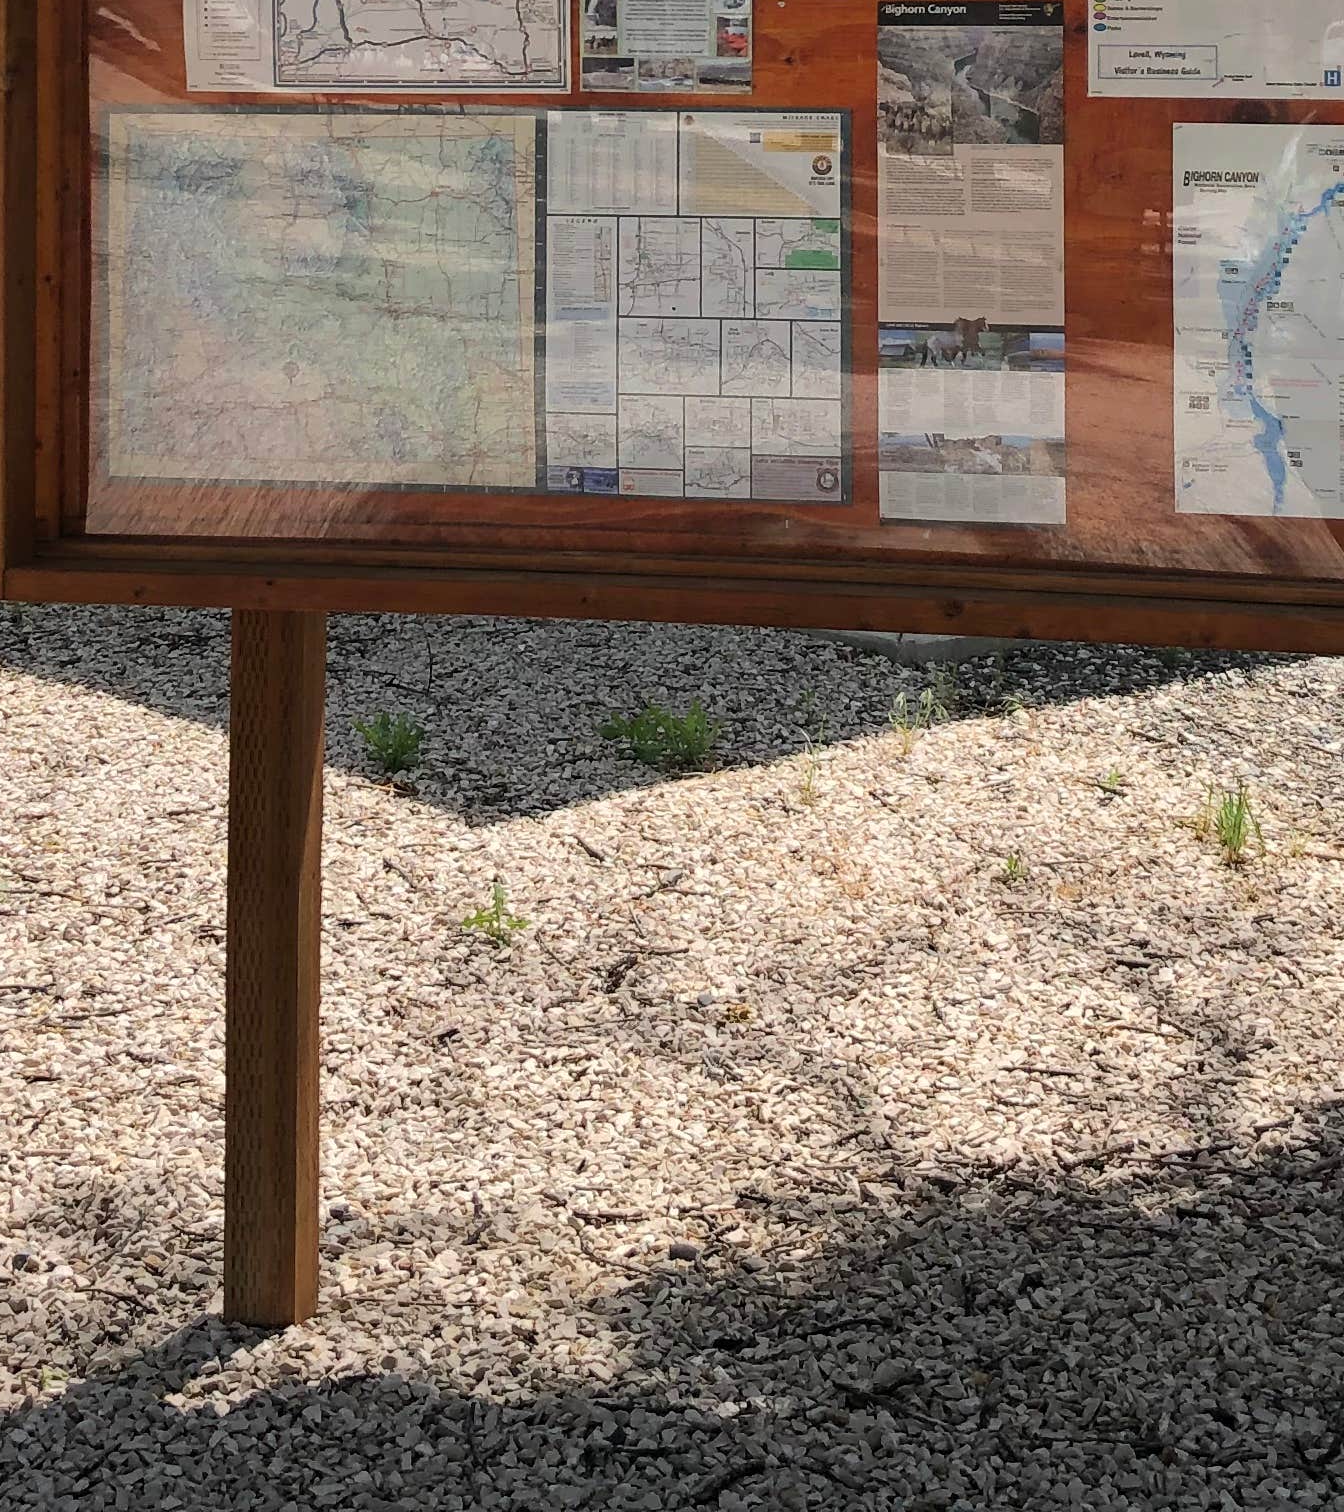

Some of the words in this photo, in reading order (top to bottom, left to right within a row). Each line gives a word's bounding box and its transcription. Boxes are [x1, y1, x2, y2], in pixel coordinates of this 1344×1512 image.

[885, 4, 926, 16] Bighorn
[927, 4, 967, 16] Canyon
[1327, 72, 1338, 85] H
[1183, 170, 1223, 186] BIGHORN
[1224, 171, 1260, 183] CANYON
